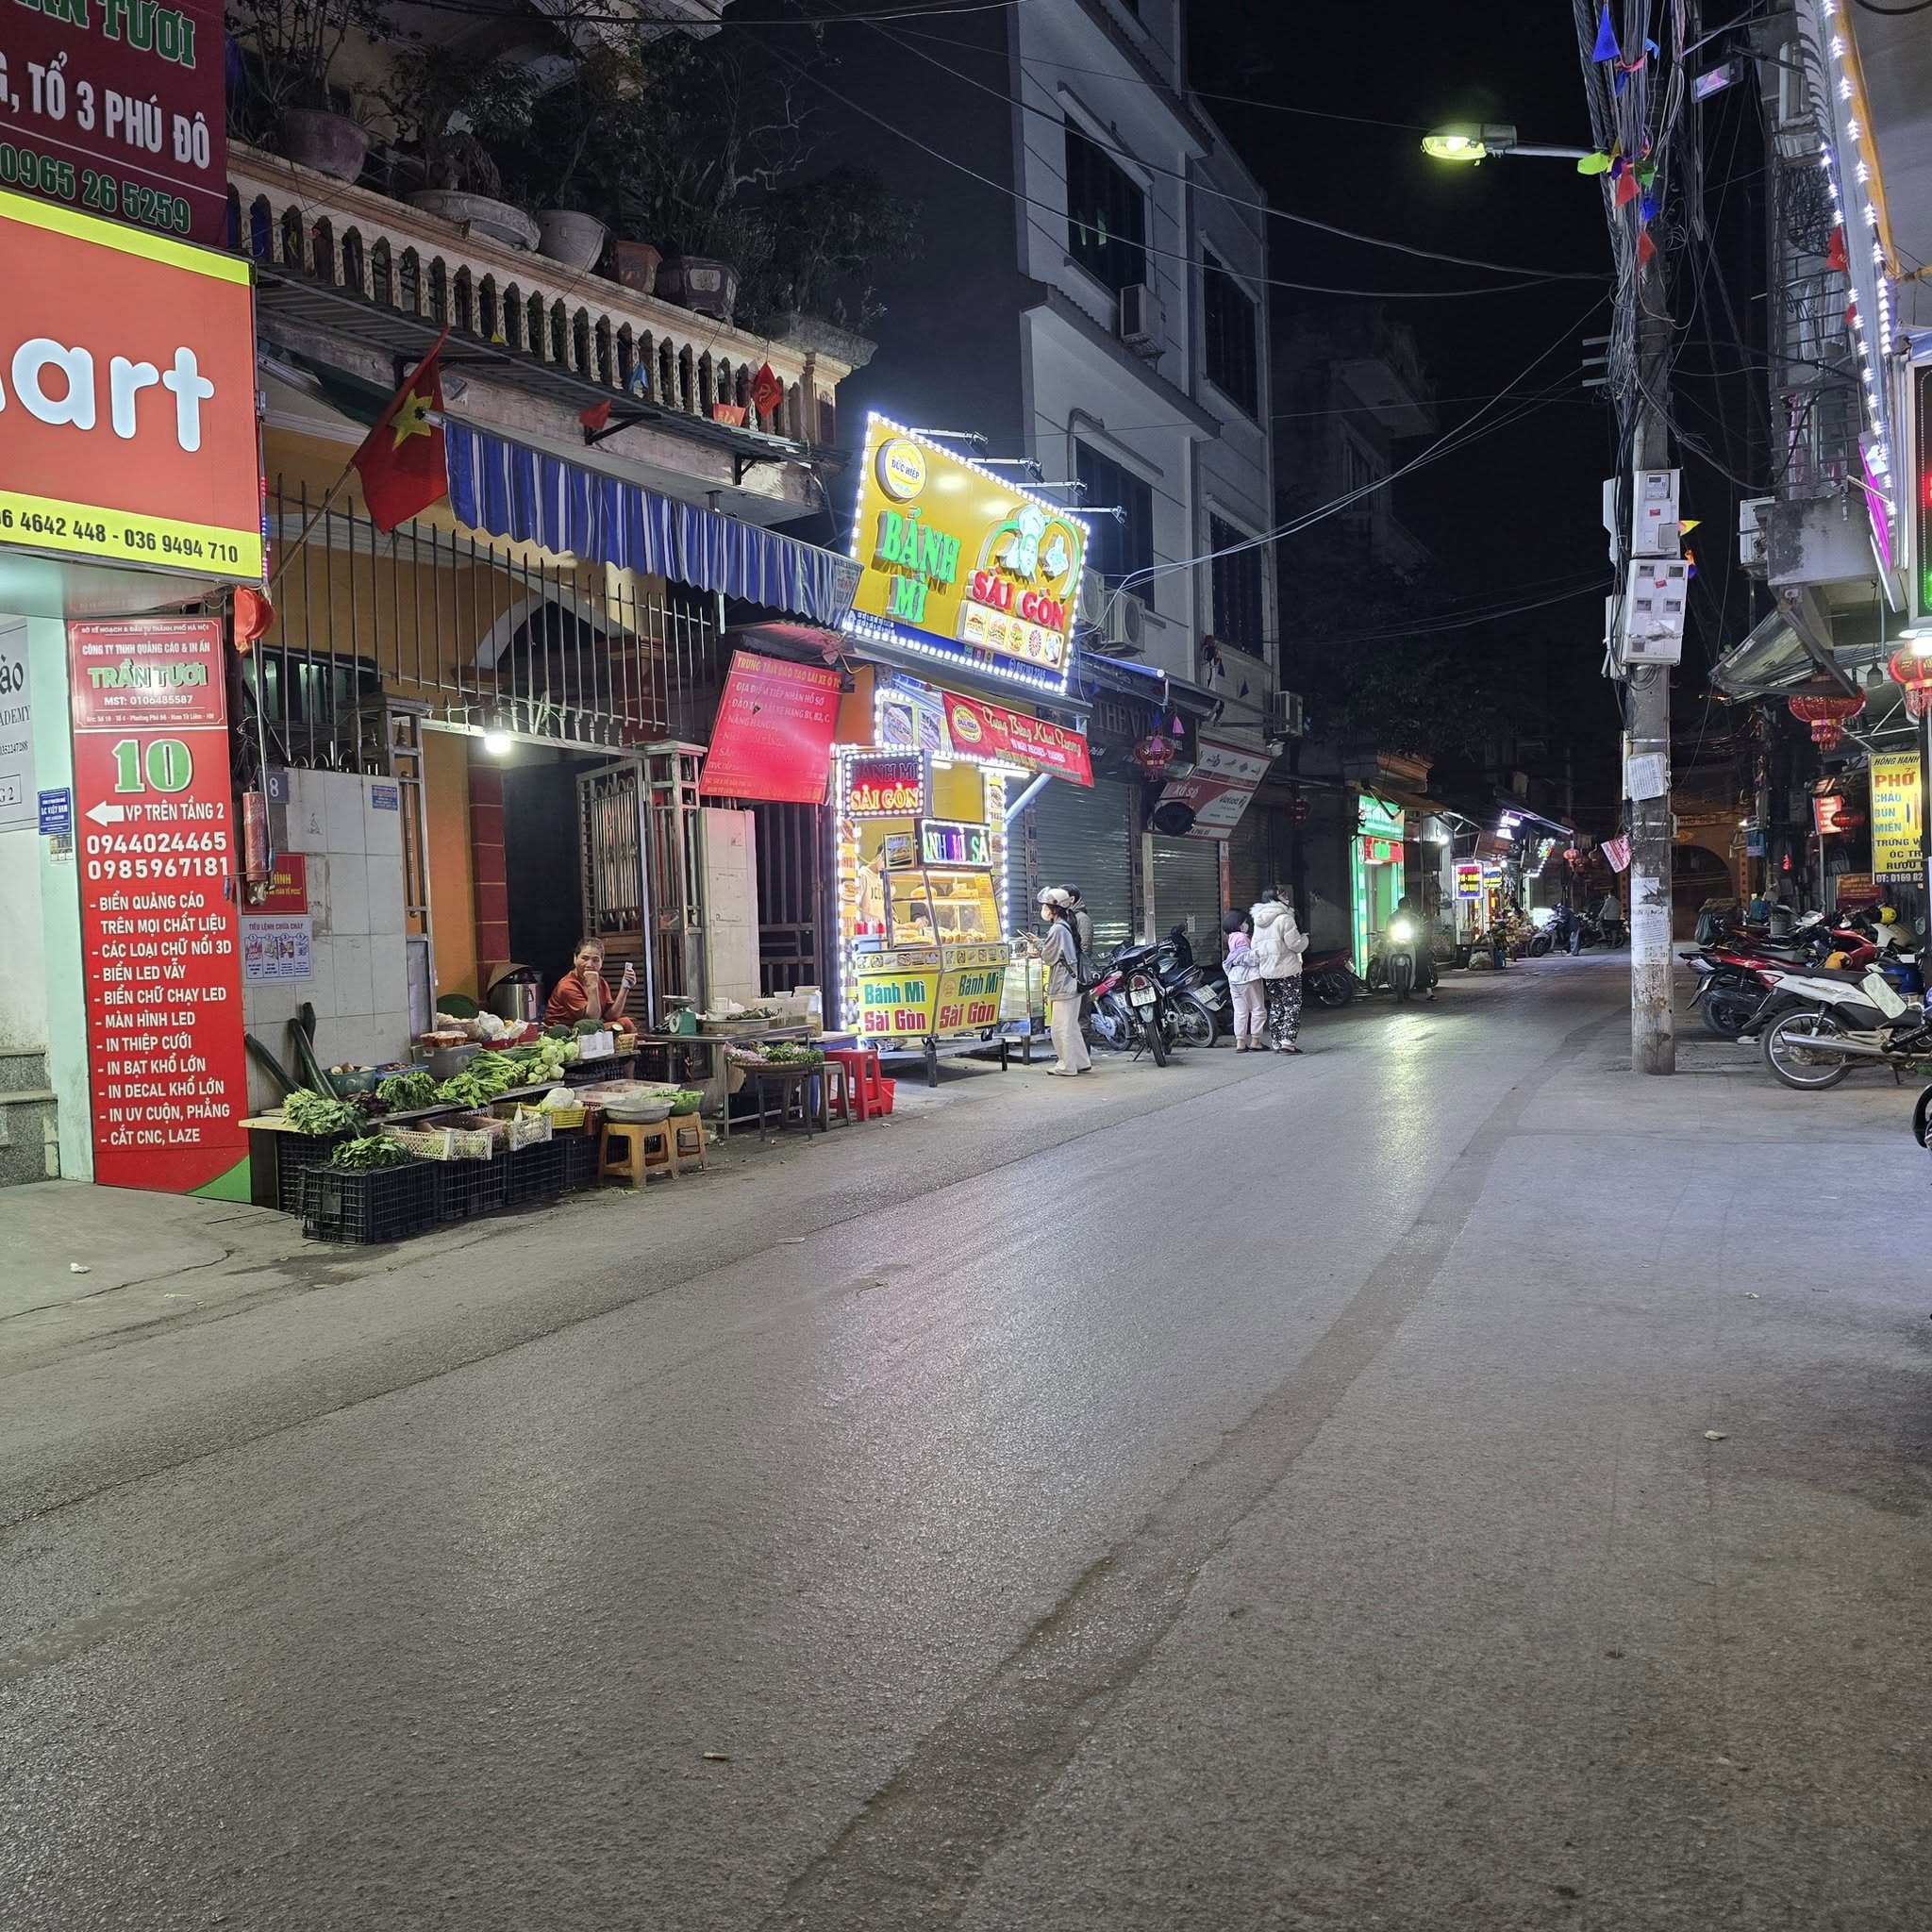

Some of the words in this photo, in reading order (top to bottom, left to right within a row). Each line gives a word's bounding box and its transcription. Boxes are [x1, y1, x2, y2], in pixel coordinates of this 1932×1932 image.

[27, 51, 68, 121] TỔ
[76, 80, 94, 130] 3
[105, 90, 162, 153] PHÚ
[173, 111, 210, 170] ĐÔ
[0, 143, 75, 200] 0965
[82, 169, 117, 212] 26
[122, 181, 191, 234] 5259
[0, 338, 215, 453] art
[20, 511, 66, 537] 4642
[73, 520, 106, 542] 448
[125, 528, 157, 551] 036
[162, 534, 203, 558] 9494
[208, 541, 239, 563] 710
[82, 642, 104, 656] CÔNG
[105, 643, 113, 655] TY
[115, 643, 135, 655] TNHH
[137, 640, 163, 655] QUẢNG
[164, 641, 179, 654] CÁO
[181, 642, 188, 653] &
[189, 641, 197, 653] IN
[87, 658, 151, 689] TRẦN
[151, 661, 208, 688] TƯƠI
[104, 696, 127, 707] MST:
[111, 739, 192, 792] 10
[1874, 767, 1916, 789] PHỞ
[8, 786, 14, 801] 2
[270, 776, 279, 798] 8
[125, 804, 142, 822] VP
[144, 798, 177, 822] TRÊN
[180, 794, 213, 821] TẦNG
[217, 803, 225, 819] 2
[86, 831, 226, 855] 0944024465
[88, 857, 228, 880] 0985967181
[99, 890, 128, 911] BIỂN
[132, 891, 176, 910] QUẢNG
[179, 891, 205, 908] CÁO
[100, 916, 134, 935] TRÊN
[138, 919, 160, 937] MỌI
[163, 911, 195, 932] CHẤT
[198, 913, 226, 935] LIỆU
[102, 940, 126, 958] CÁC
[129, 941, 158, 958] LOẠI
[160, 938, 188, 956] CHỮ
[191, 934, 212, 955] NỔI
[216, 940, 231, 954] 3D
[103, 960, 132, 982] BIỂN
[136, 965, 160, 980] LED
[162, 957, 186, 979] VẪY
[104, 984, 133, 1006] BIỂN
[137, 985, 164, 1004] CHỮ
[167, 988, 199, 1006] CHẠY
[202, 987, 226, 1002] LED
[863, 982, 901, 1005] Bánh
[905, 979, 925, 1003] Mì
[958, 973, 985, 997] Bánh
[986, 970, 999, 994] Mì
[105, 1010, 133, 1028] MÀN
[137, 1009, 168, 1027] HÌNH
[172, 1011, 195, 1026] LED
[863, 1008, 889, 1032] Sài
[894, 1008, 926, 1030] Gòn
[939, 1003, 963, 1029] Sài
[967, 1001, 996, 1024] Gòn
[106, 1038, 119, 1052] IN
[122, 1033, 158, 1055] THIỆP
[161, 1031, 192, 1049] CƯỚI
[107, 1061, 120, 1075] IN
[124, 1060, 148, 1078] BẠT
[150, 1052, 176, 1074] KHỔ
[180, 1054, 206, 1073] LỚN
[108, 1084, 121, 1099] IN
[125, 1083, 166, 1098] DECAL
[169, 1074, 195, 1096] KHỔ
[198, 1076, 225, 1095] LỚN
[109, 1108, 122, 1123] IN
[125, 1107, 142, 1122] UV
[146, 1102, 184, 1124] CUỘN,
[187, 1097, 230, 1119] PHẲNG
[110, 1124, 134, 1145] CẮT
[137, 1130, 165, 1146] CNC,
[168, 1128, 201, 1143] LAZE
